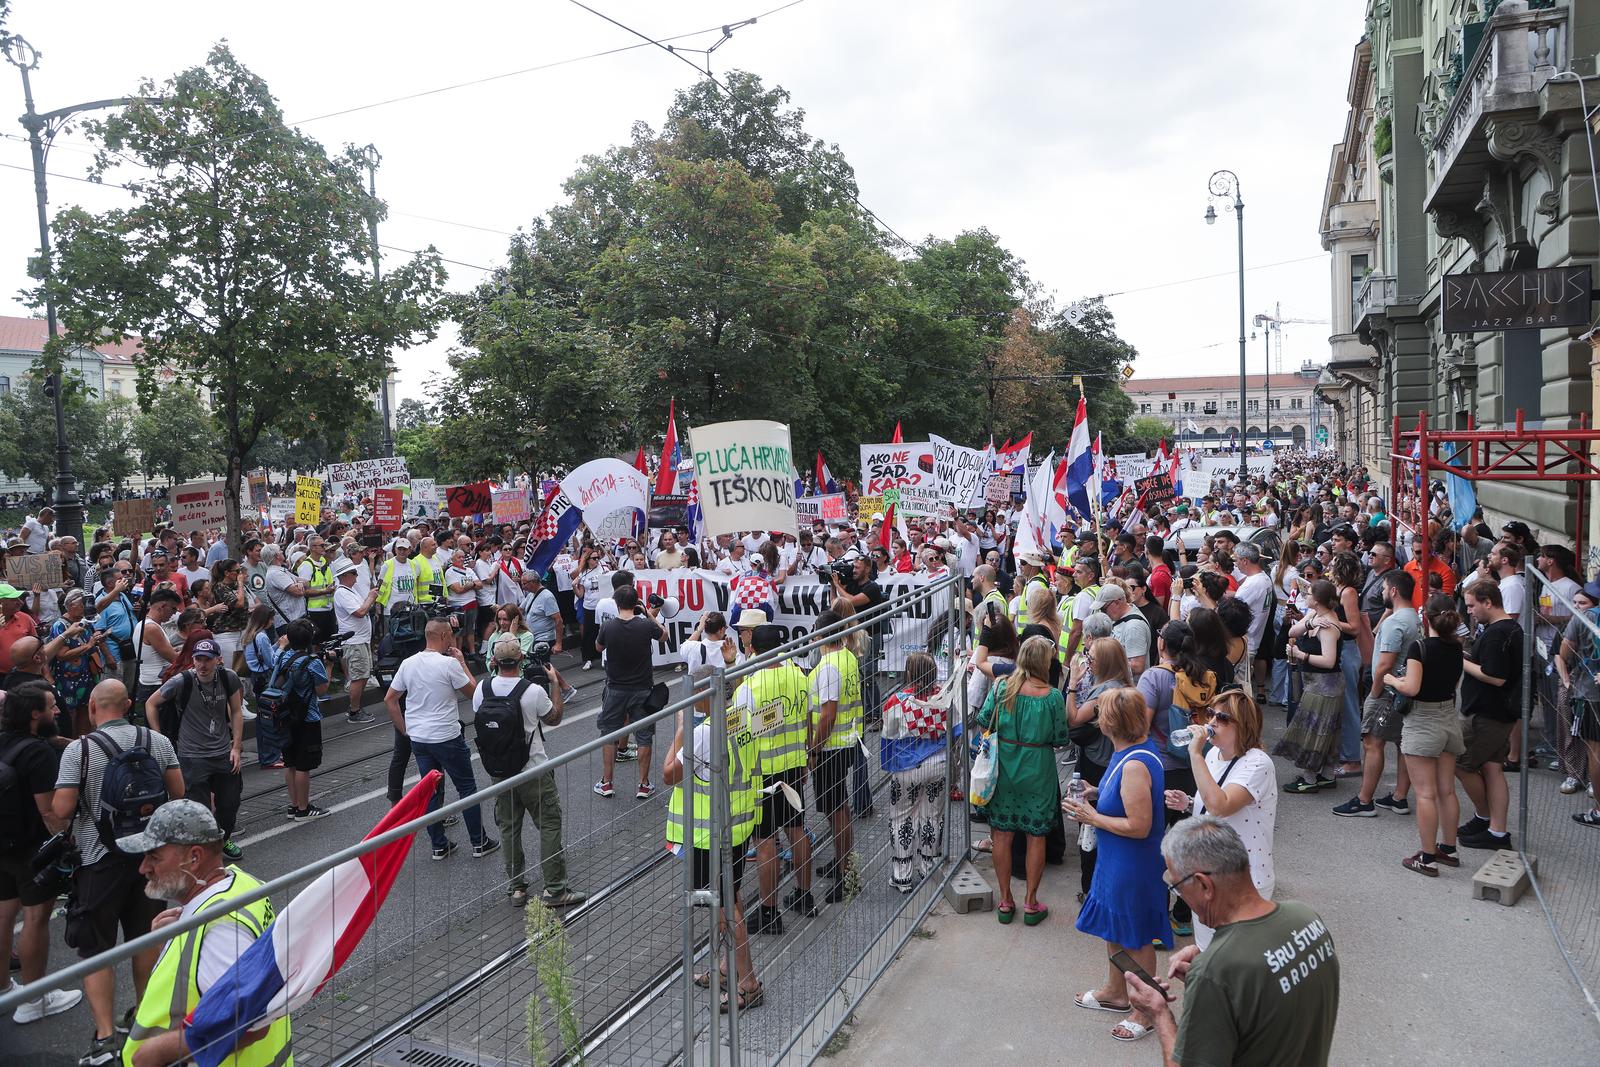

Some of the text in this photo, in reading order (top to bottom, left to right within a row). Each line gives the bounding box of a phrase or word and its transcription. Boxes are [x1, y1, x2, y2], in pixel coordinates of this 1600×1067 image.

[1447, 271, 1585, 310] BACCHUS
[1471, 314, 1560, 329] JAZZ BAR
[332, 458, 400, 473] DECA MOJA DECA
[696, 443, 752, 476] PLUĆA
[867, 451, 910, 466] AKO NE
[870, 464, 909, 479] SAD,
[709, 474, 772, 507] TEŠKO
[202, 514, 229, 526] MIROVA
[636, 578, 704, 611] DAJU
[1263, 919, 1328, 974] ŠRU ŠTUKA
